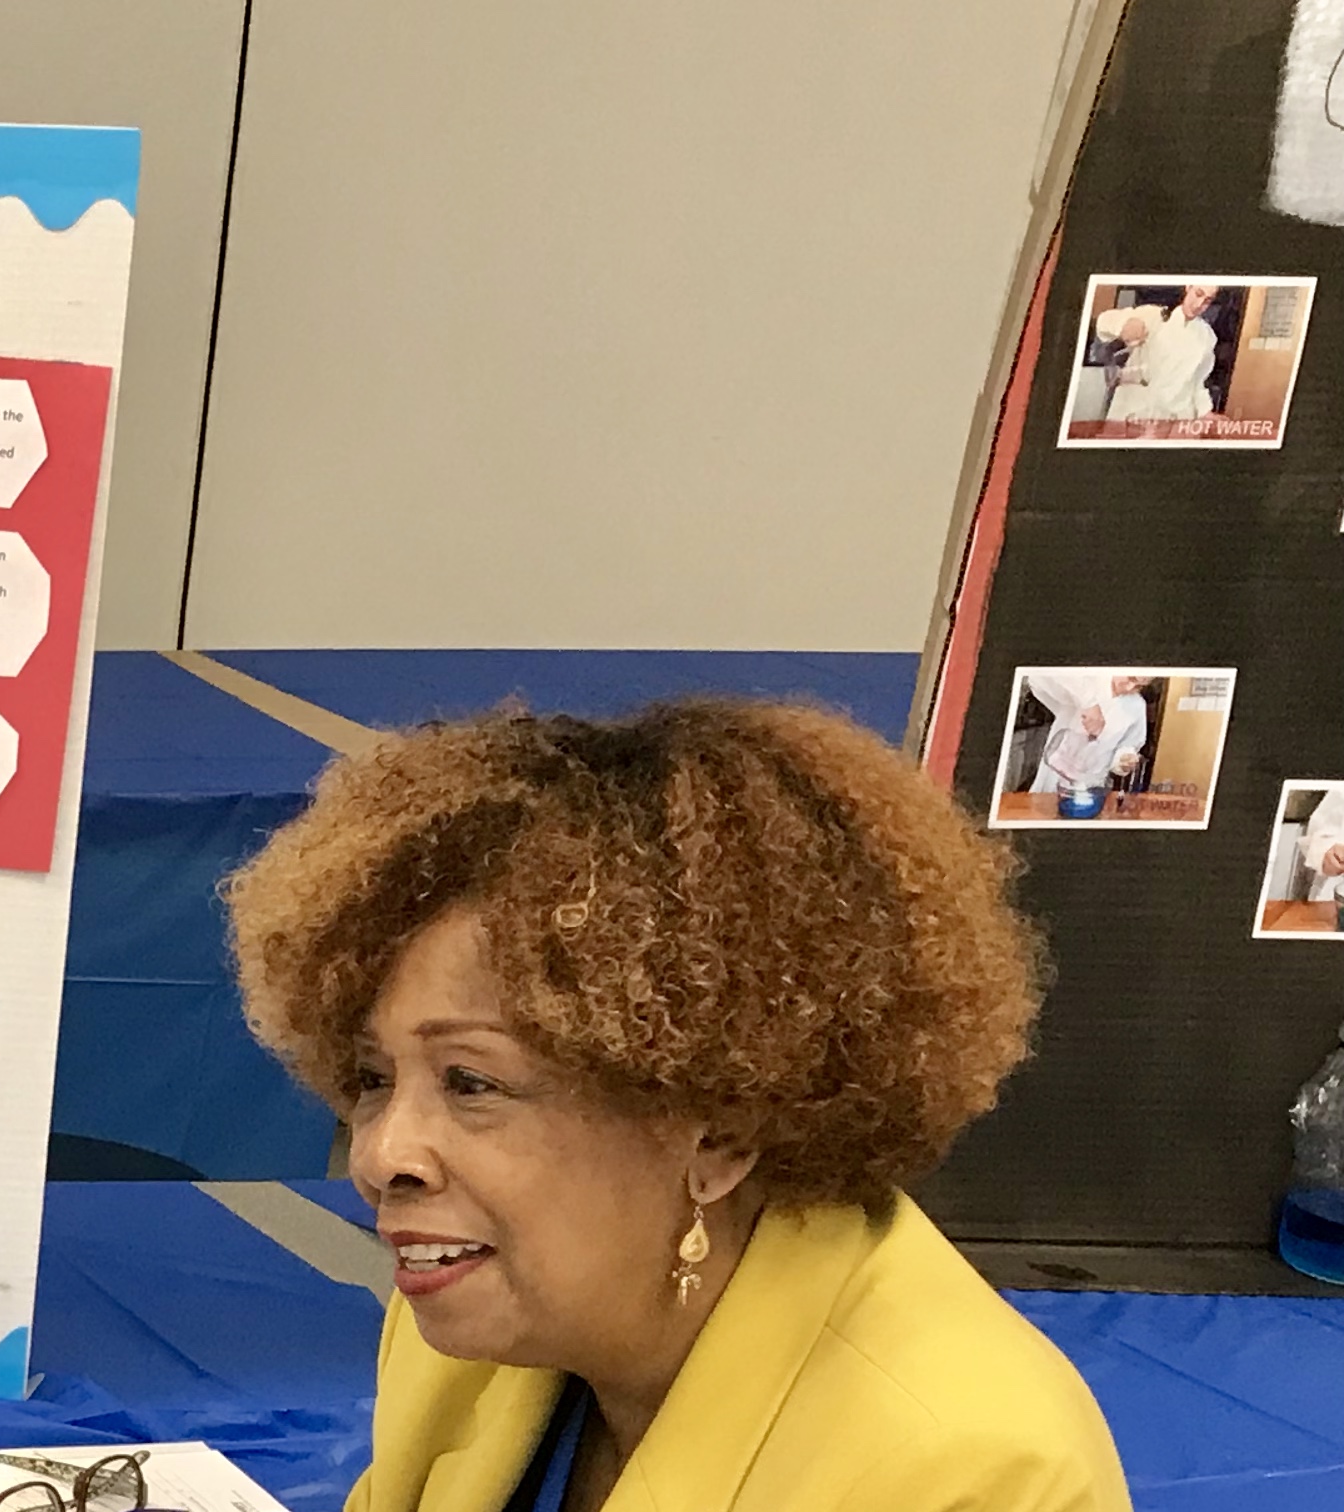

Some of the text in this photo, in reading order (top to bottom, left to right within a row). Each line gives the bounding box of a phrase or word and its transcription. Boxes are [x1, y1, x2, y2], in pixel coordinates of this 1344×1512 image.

[3, 408, 24, 423] the
[1179, 420, 1274, 435] HOT WATER
